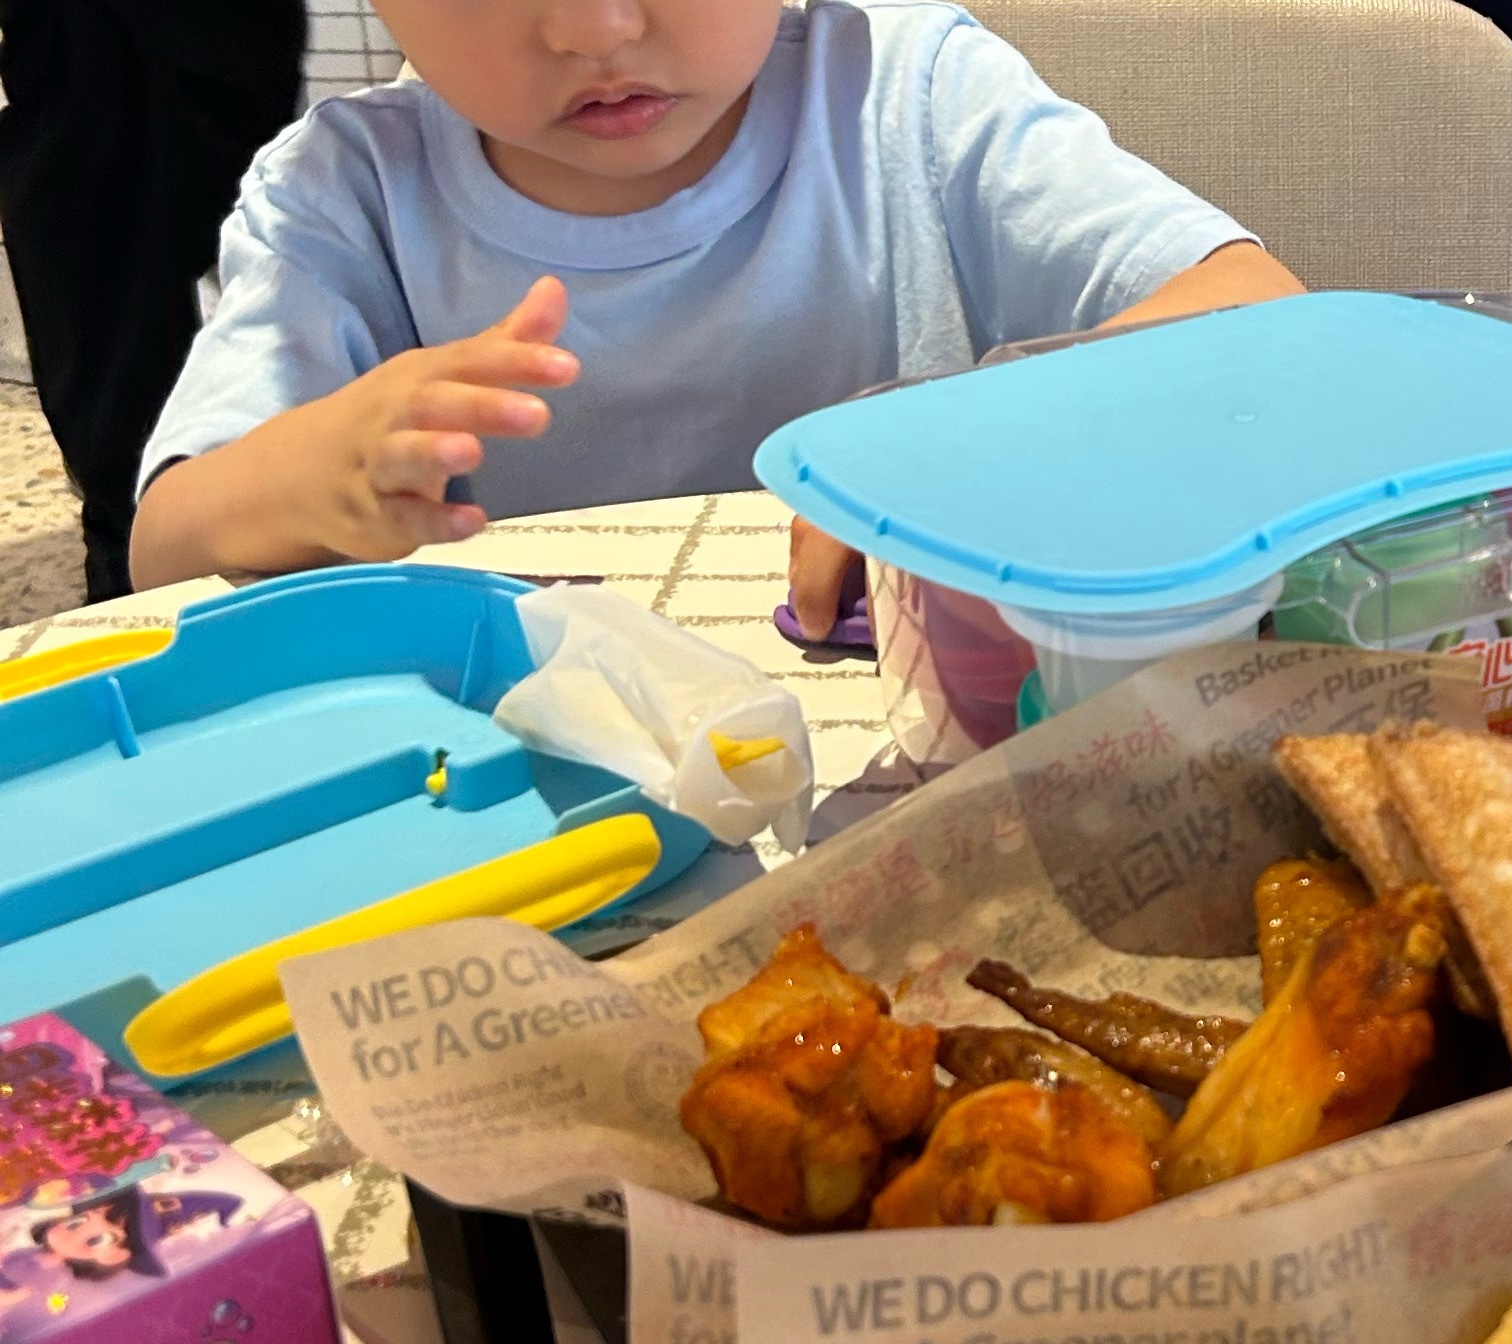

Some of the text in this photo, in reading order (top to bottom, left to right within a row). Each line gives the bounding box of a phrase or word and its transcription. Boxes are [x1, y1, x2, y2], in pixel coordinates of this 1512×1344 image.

[330, 973, 418, 1031] WE
[418, 955, 497, 1009] DO
[351, 1036, 423, 1083] for
[431, 1021, 471, 1066] A
[810, 1277, 904, 1336] WE
[916, 1271, 1003, 1326] DO
[1009, 1258, 1260, 1316] CHICKEN
[1270, 1219, 1391, 1303] RIGHT
